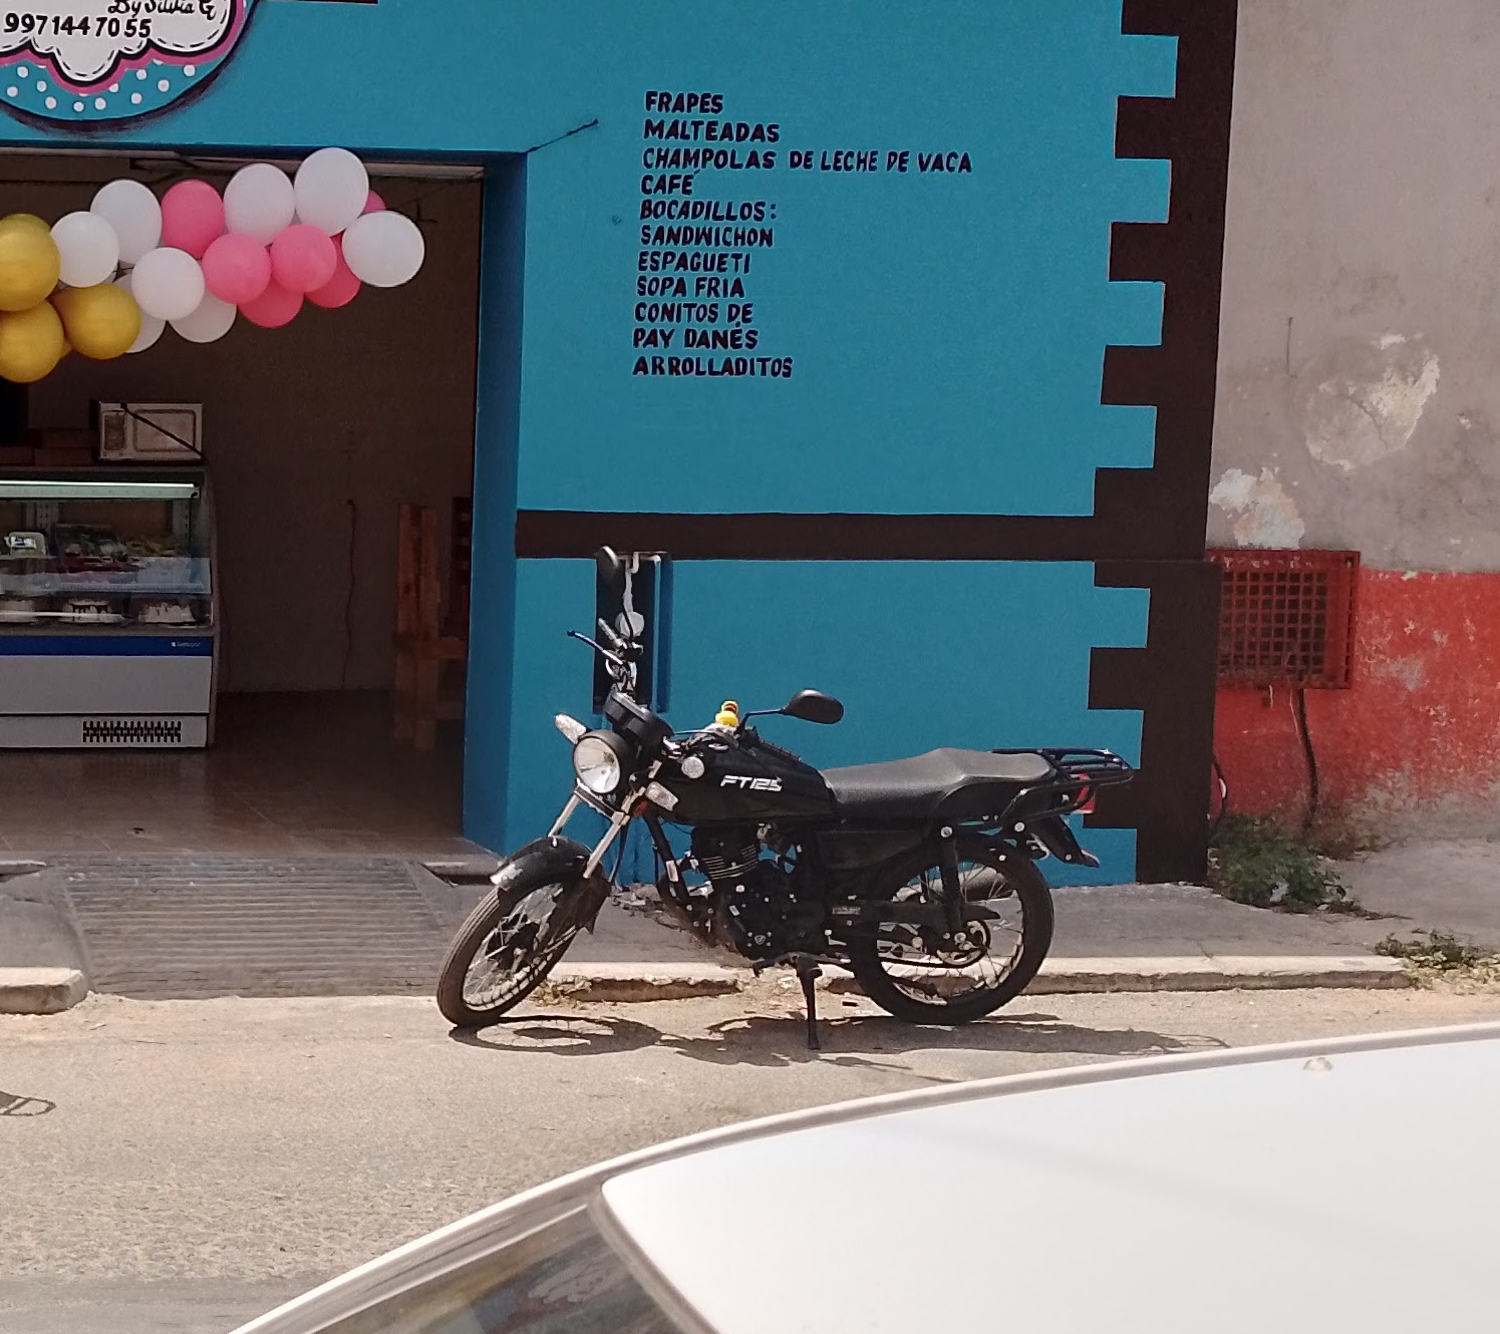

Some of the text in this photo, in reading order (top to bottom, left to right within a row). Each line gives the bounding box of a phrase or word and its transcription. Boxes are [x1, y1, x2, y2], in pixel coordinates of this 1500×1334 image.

[645, 90, 724, 115] FRAPES
[643, 118, 780, 143] MALTEADAS
[643, 147, 972, 173] CHAMPOLAS DE LECHE DE VACA
[639, 198, 777, 222] BOCADILLOS:
[640, 224, 773, 248] SANDWICHON
[638, 250, 751, 275] ESPAGUETI
[636, 275, 745, 299] SOPA FRIA
[634, 301, 754, 326] CONITOS DE
[633, 320, 759, 350] PAY DANÉS
[632, 355, 793, 379] ARROLLADITOS
